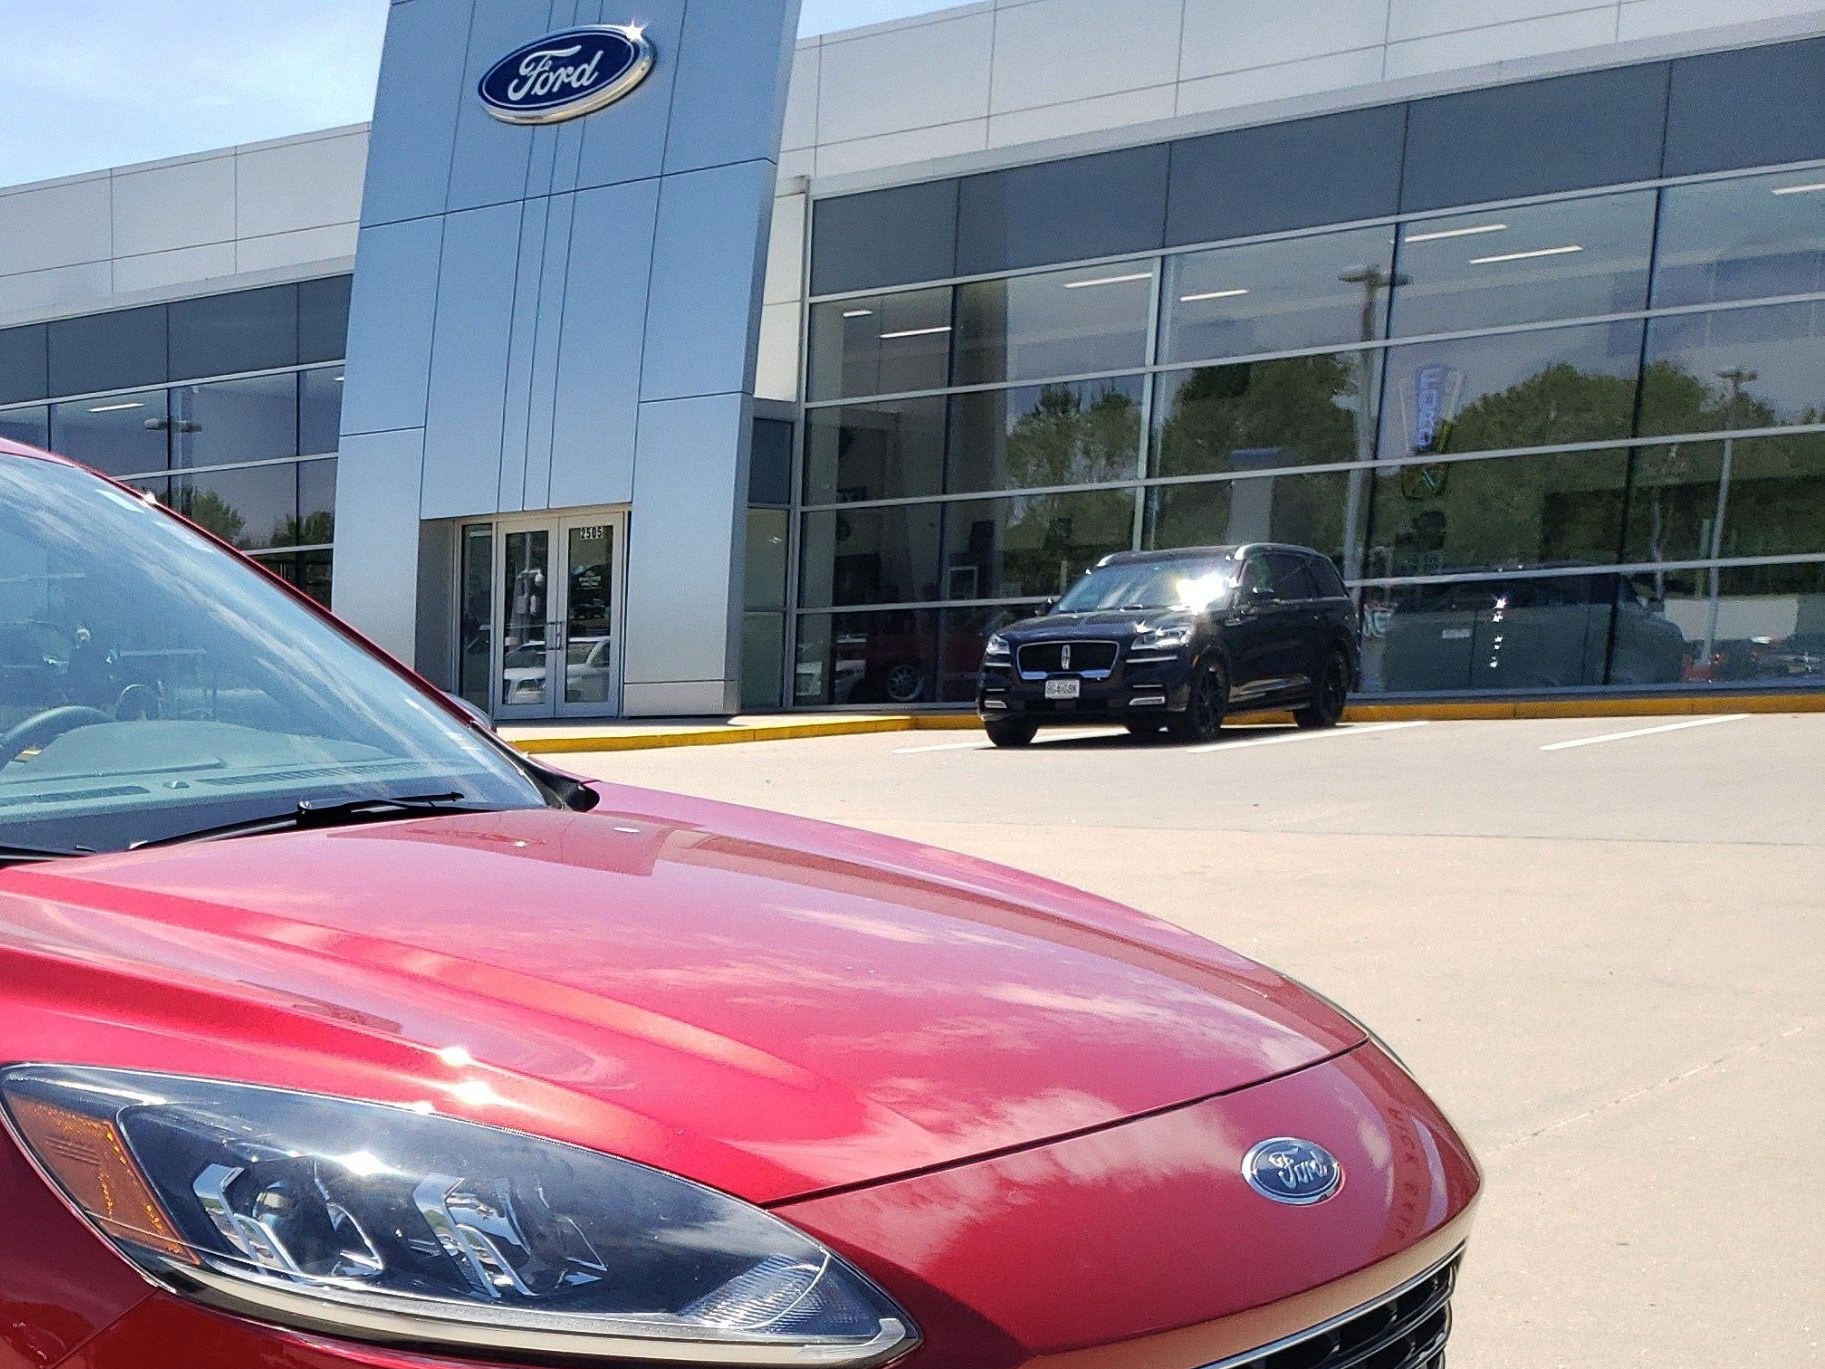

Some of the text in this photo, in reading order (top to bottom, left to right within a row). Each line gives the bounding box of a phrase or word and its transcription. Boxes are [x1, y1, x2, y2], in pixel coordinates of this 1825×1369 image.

[507, 45, 604, 101] Ford
[580, 526, 603, 539] 2505
[1268, 1146, 1328, 1190] Ford
